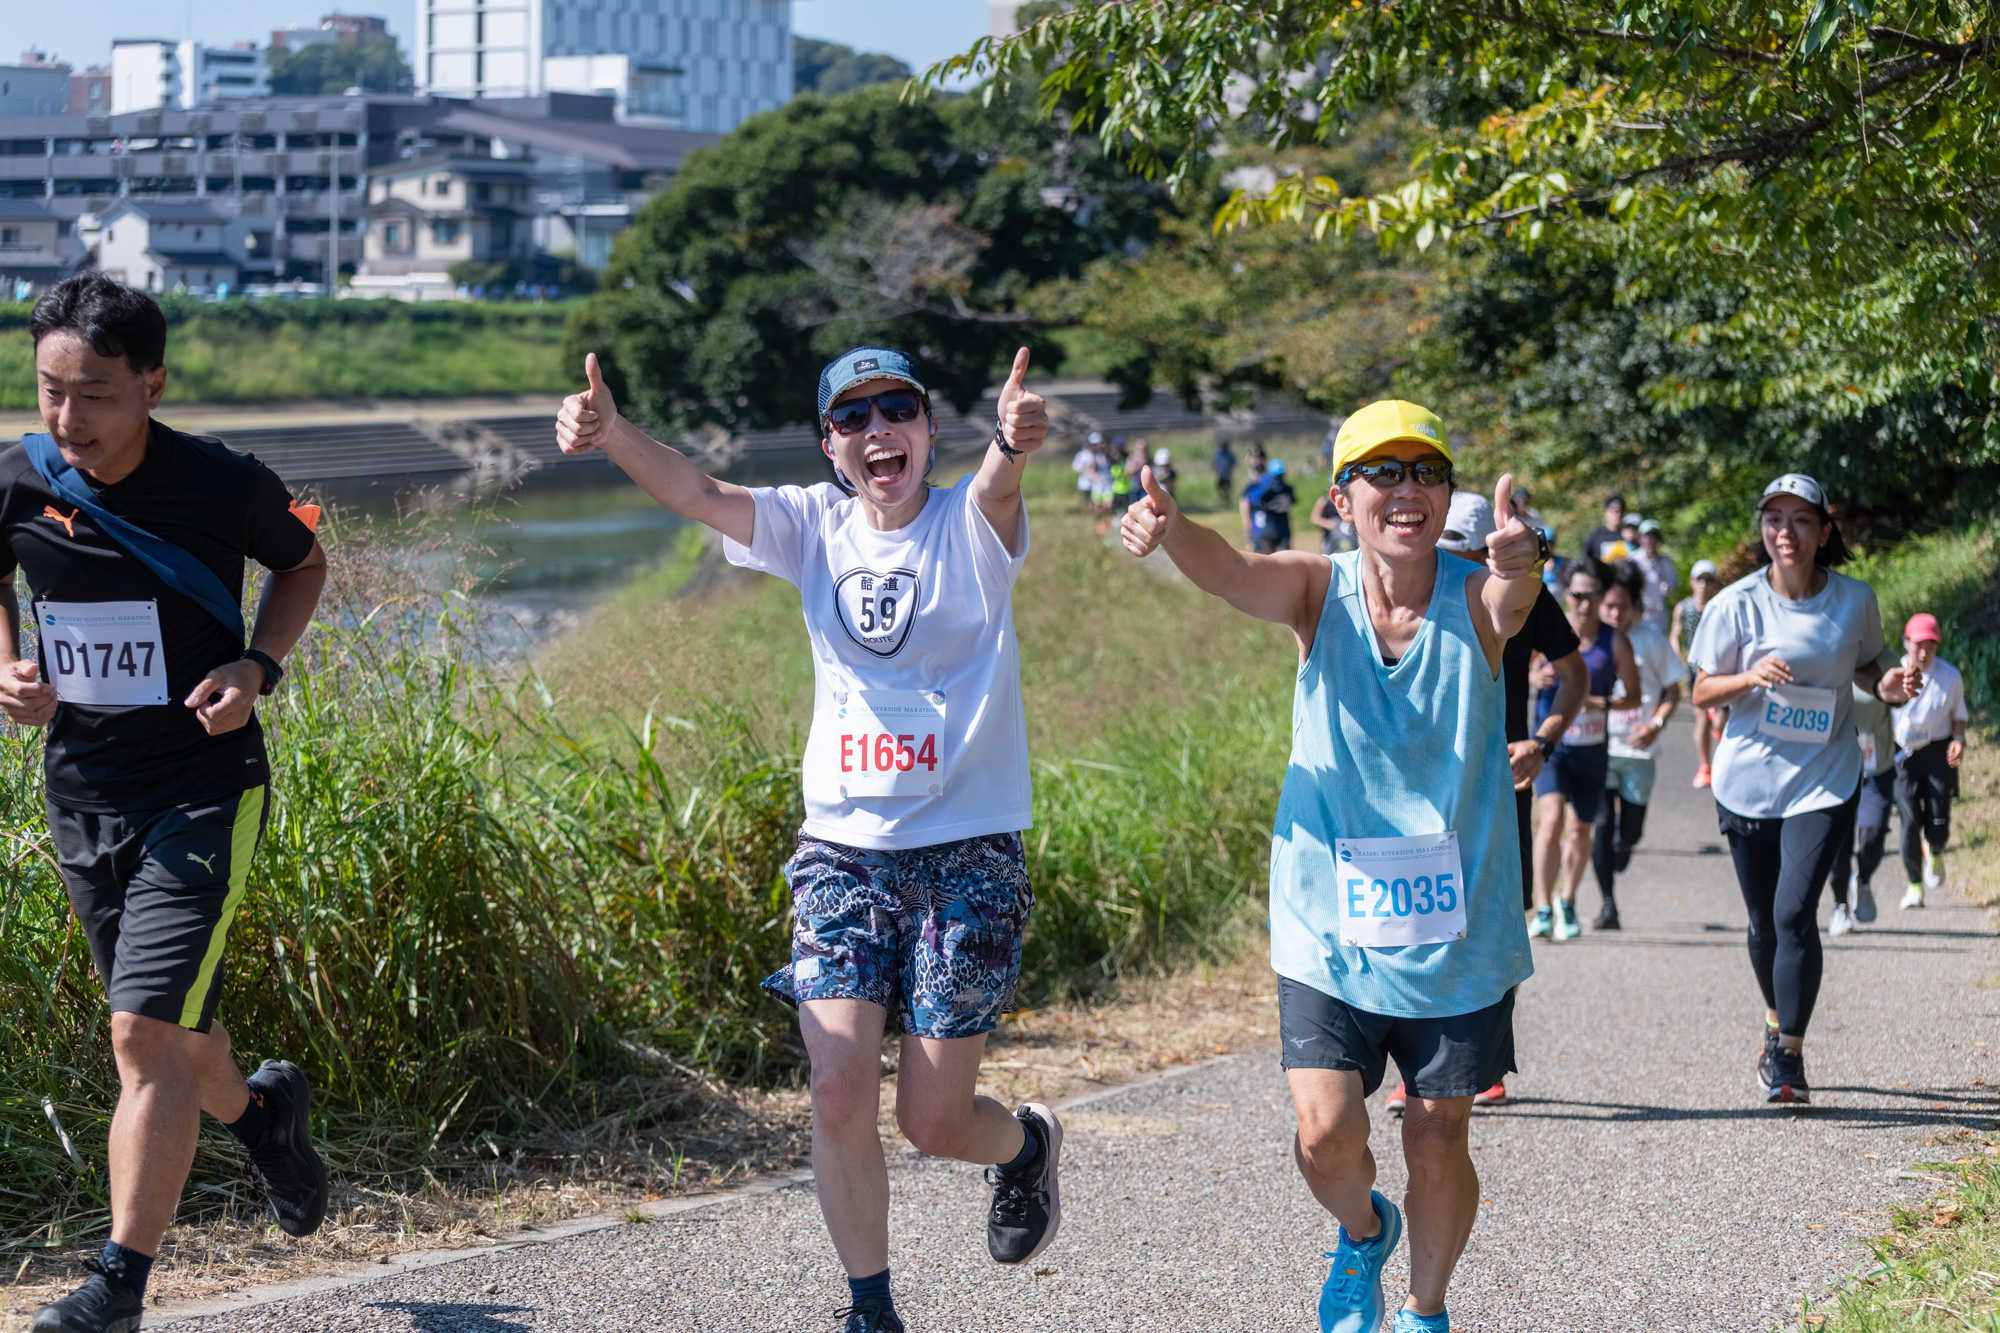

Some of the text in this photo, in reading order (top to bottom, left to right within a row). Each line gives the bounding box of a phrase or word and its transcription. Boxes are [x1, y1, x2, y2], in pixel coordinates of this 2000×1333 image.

[859, 596, 897, 634] 59
[862, 635, 895, 644] ROUTE
[54, 639, 155, 679] D1747
[1765, 702, 1830, 733] E2039
[840, 733, 938, 773] E1654
[1381, 849, 1414, 857] RIVERSIDE
[1416, 844, 1452, 854] MARATHON
[1346, 873, 1457, 918] E2035
